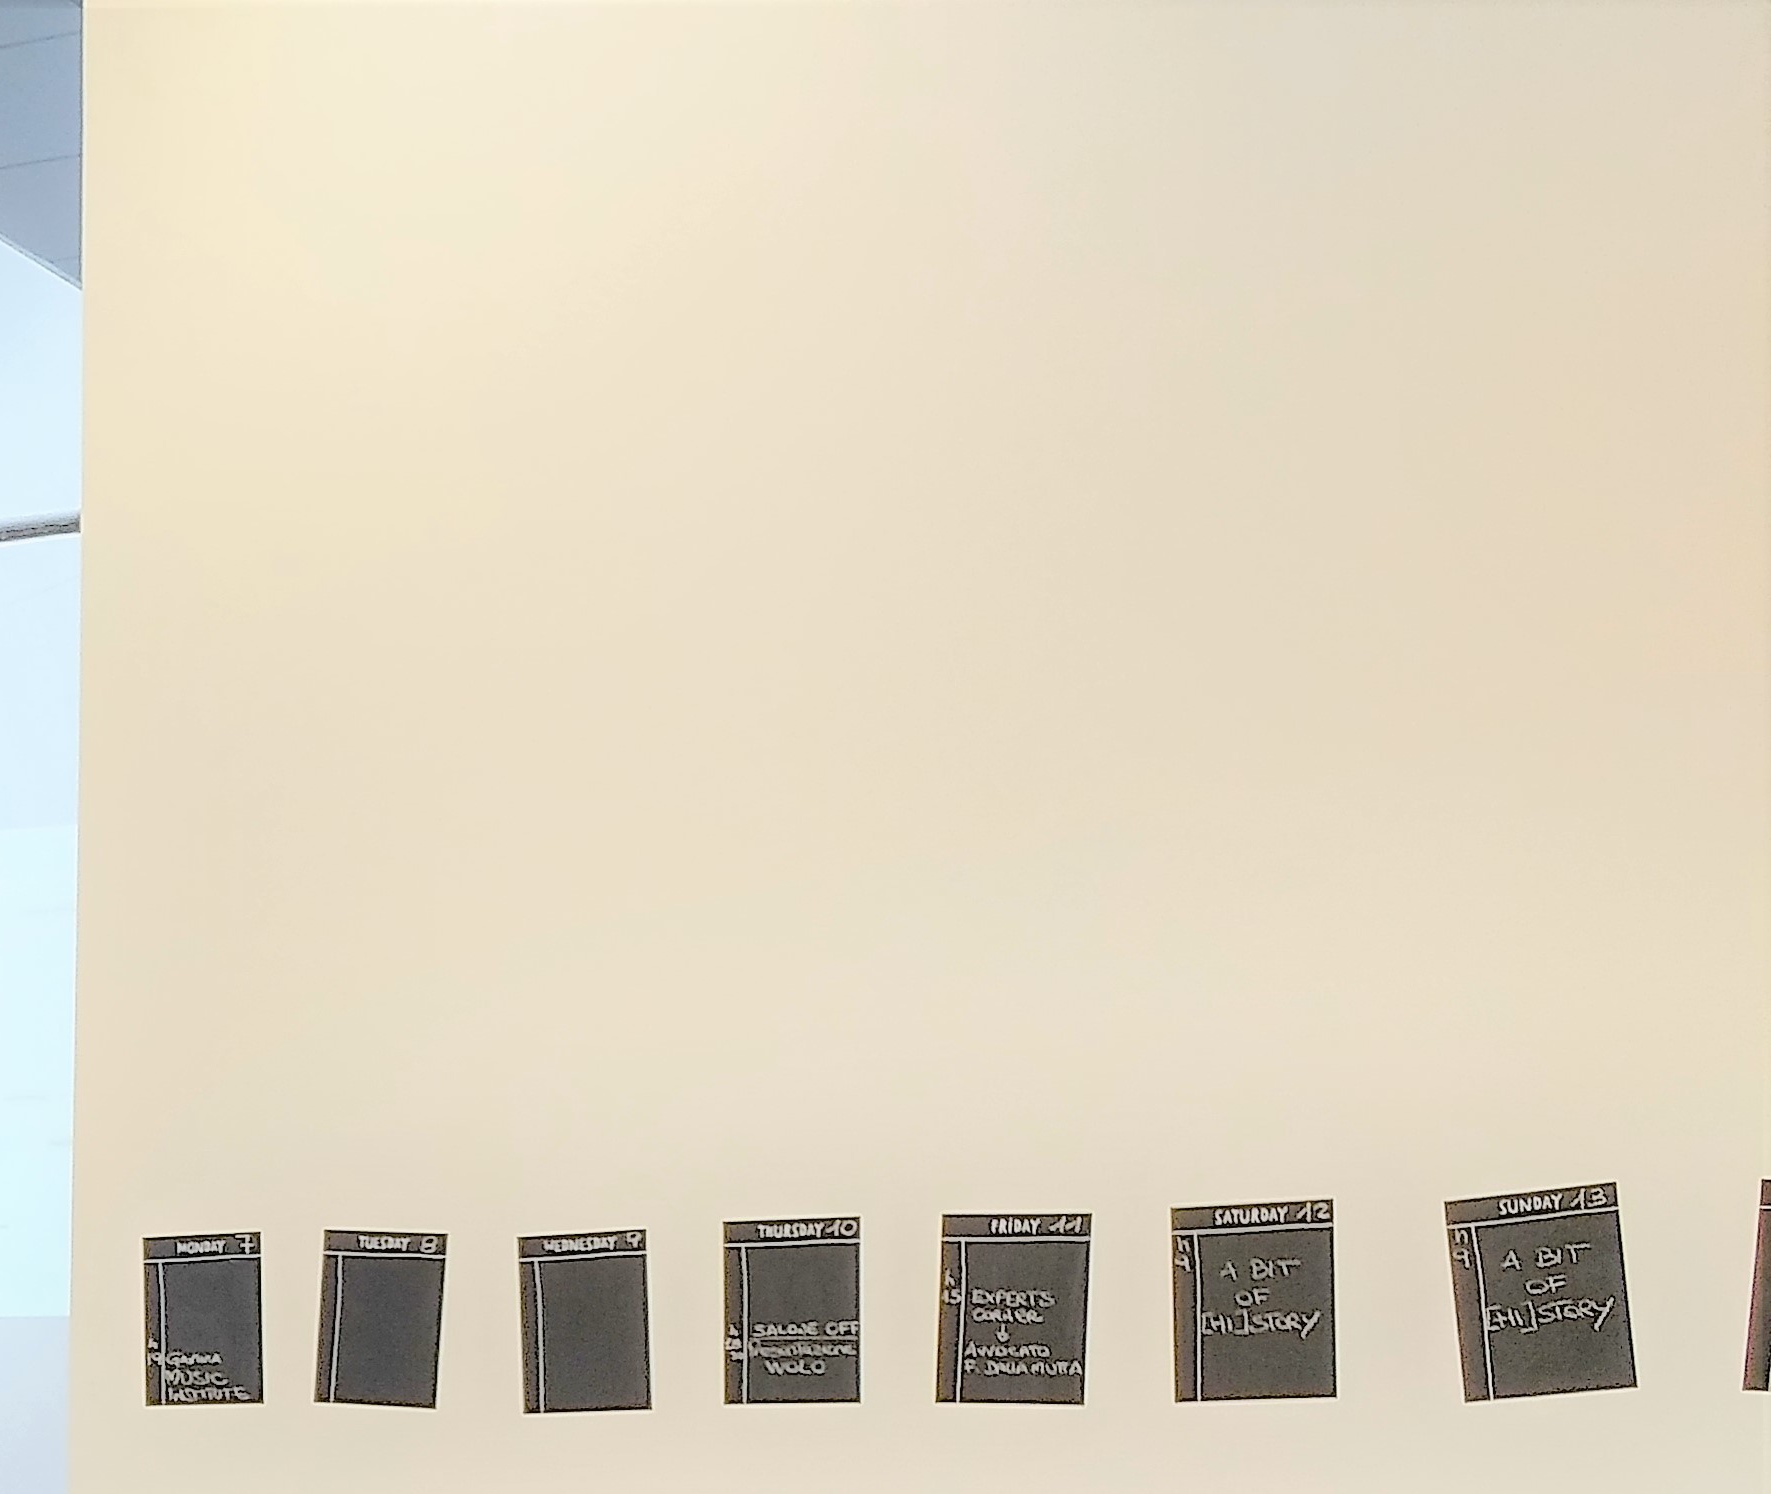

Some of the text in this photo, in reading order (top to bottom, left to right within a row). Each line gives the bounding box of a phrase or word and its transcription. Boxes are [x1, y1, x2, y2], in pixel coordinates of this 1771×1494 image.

[1498, 1187, 1608, 1216] SUNDAY 13
[1214, 1201, 1331, 1226] SATURDAY 12
[757, 1219, 857, 1239] THURSDAY 10
[990, 1216, 1083, 1235] FRIDAY 11
[176, 1234, 256, 1255] MONDAY 7
[358, 1234, 438, 1254] TUESDAY 8
[541, 1235, 618, 1253] WEDNESDAY
[1502, 1242, 1591, 1271] A BIT
[1220, 1257, 1302, 1282] A BIT
[1525, 1274, 1567, 1296] OF
[971, 1288, 1057, 1308] EXPERTS
[1234, 1287, 1271, 1308] OF
[972, 1307, 1045, 1324] CORNER
[752, 1320, 859, 1337] SALONE OFF
[165, 1368, 230, 1386] MUSIC
[764, 1359, 826, 1376] WOLO
